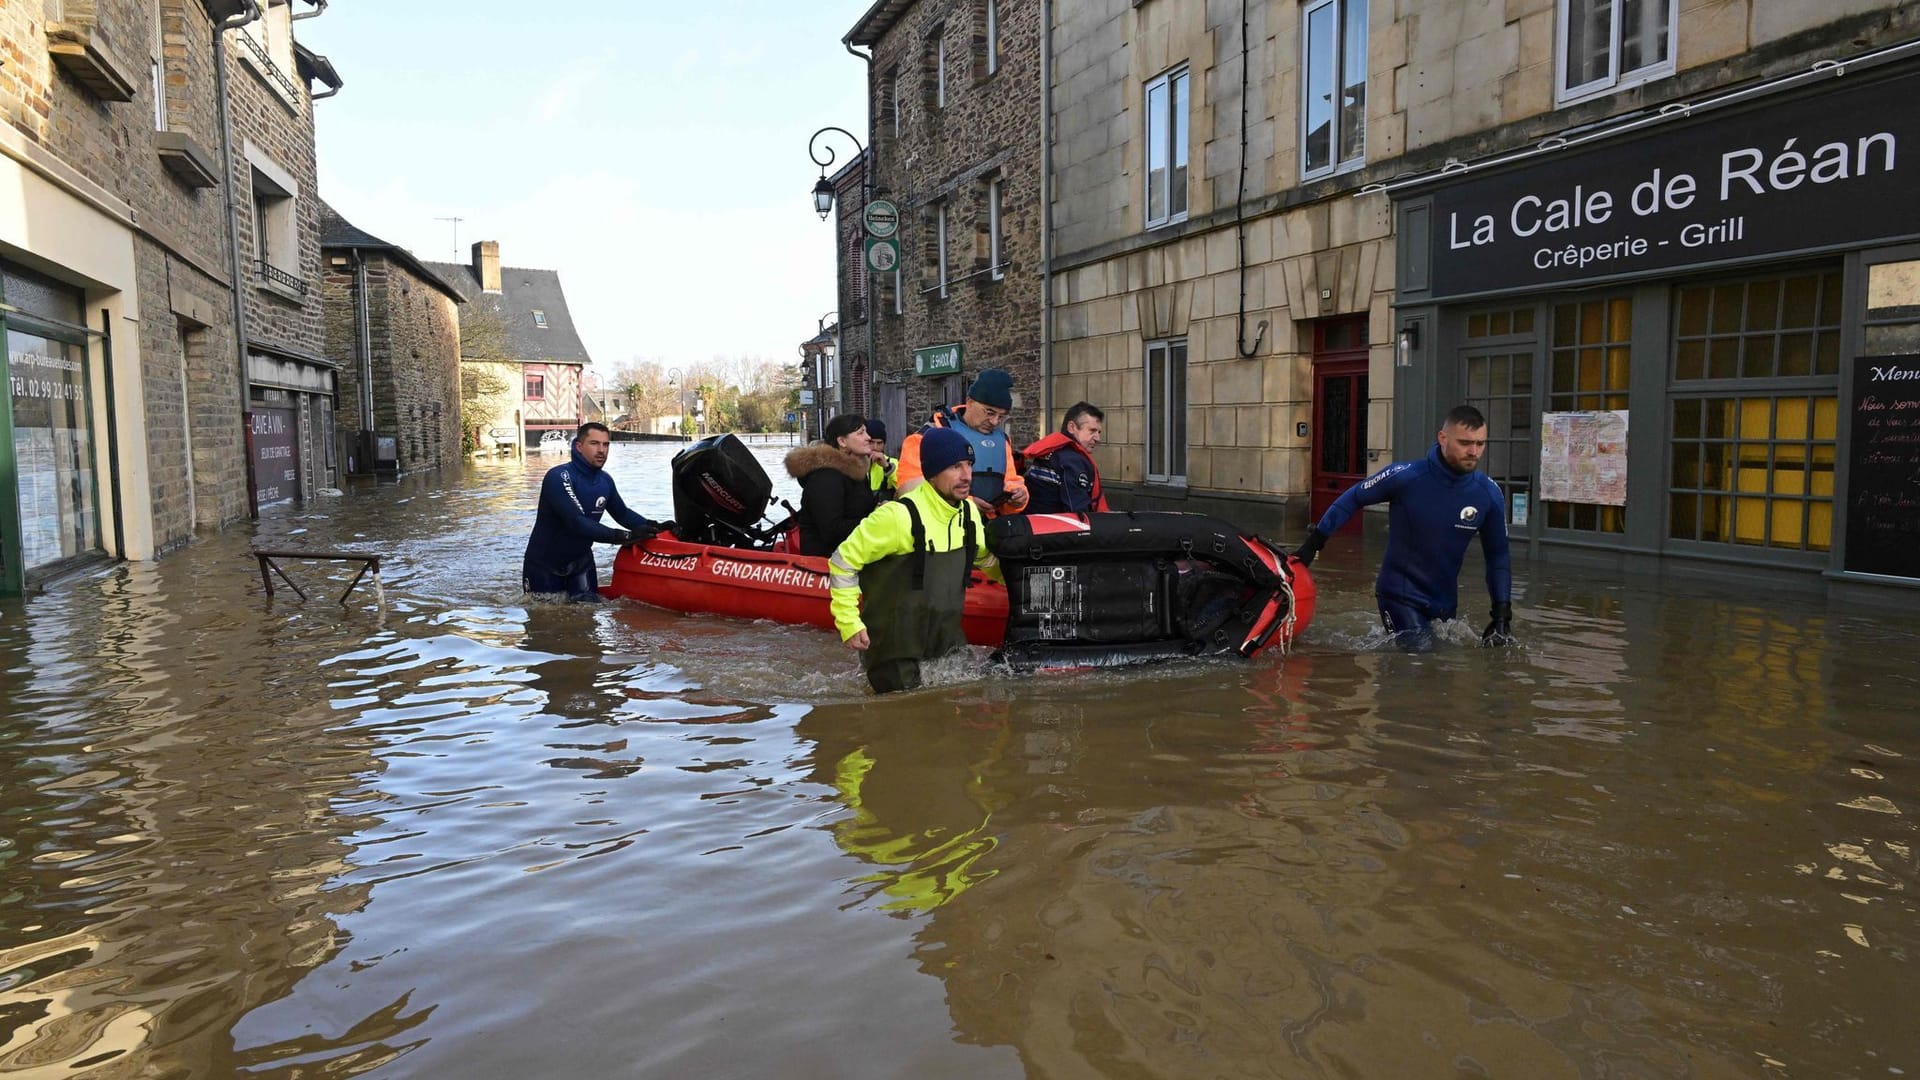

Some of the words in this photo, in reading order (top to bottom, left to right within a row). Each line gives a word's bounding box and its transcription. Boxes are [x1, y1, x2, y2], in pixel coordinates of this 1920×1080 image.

[1450, 213, 1494, 250] La
[1511, 186, 1613, 237] Cale
[1632, 168, 1696, 215] de
[1720, 132, 1896, 201] Réan
[1534, 235, 1648, 269] Crêperie
[1680, 216, 1743, 247] Grill
[10, 377, 28, 396] Tél.
[29, 379, 40, 397] 02
[41, 381, 51, 398] 99
[53, 382, 63, 399] 22
[64, 383, 73, 400] 41
[74, 384, 83, 400] 55
[1857, 395, 1886, 411] Nous
[251, 415, 267, 434] CAVE
[268, 411, 273, 434] À
[273, 415, 283, 434] VIN
[702, 472, 746, 510] MERCURY
[640, 552, 698, 571] 223E0023
[711, 559, 815, 588] GENDARMERIE
